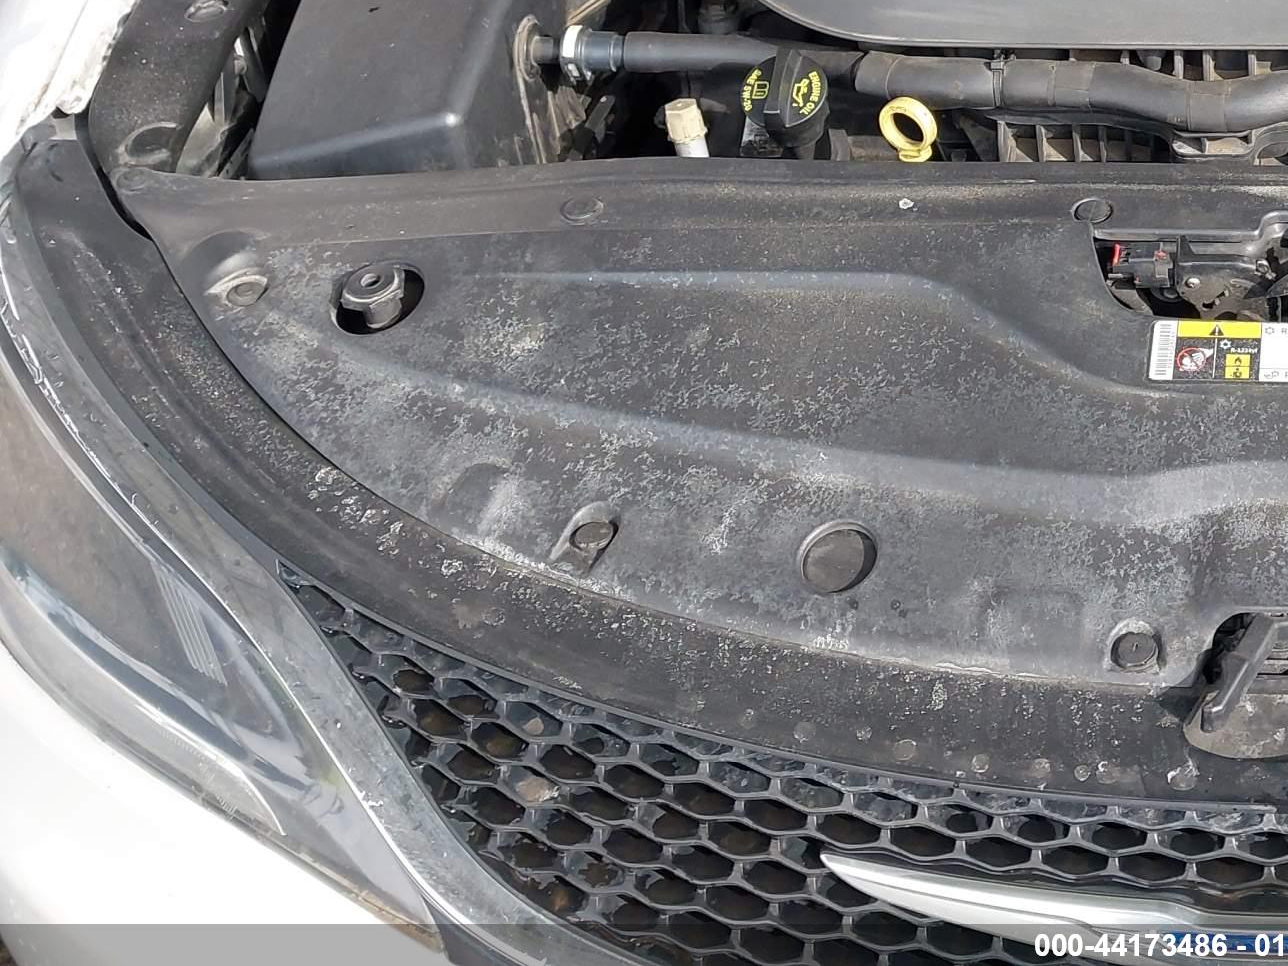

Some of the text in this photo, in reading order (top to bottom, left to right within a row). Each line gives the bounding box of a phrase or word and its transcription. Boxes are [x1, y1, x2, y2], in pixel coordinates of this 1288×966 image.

[747, 69, 762, 85] SAE
[799, 71, 821, 115] ENGINE OIL
